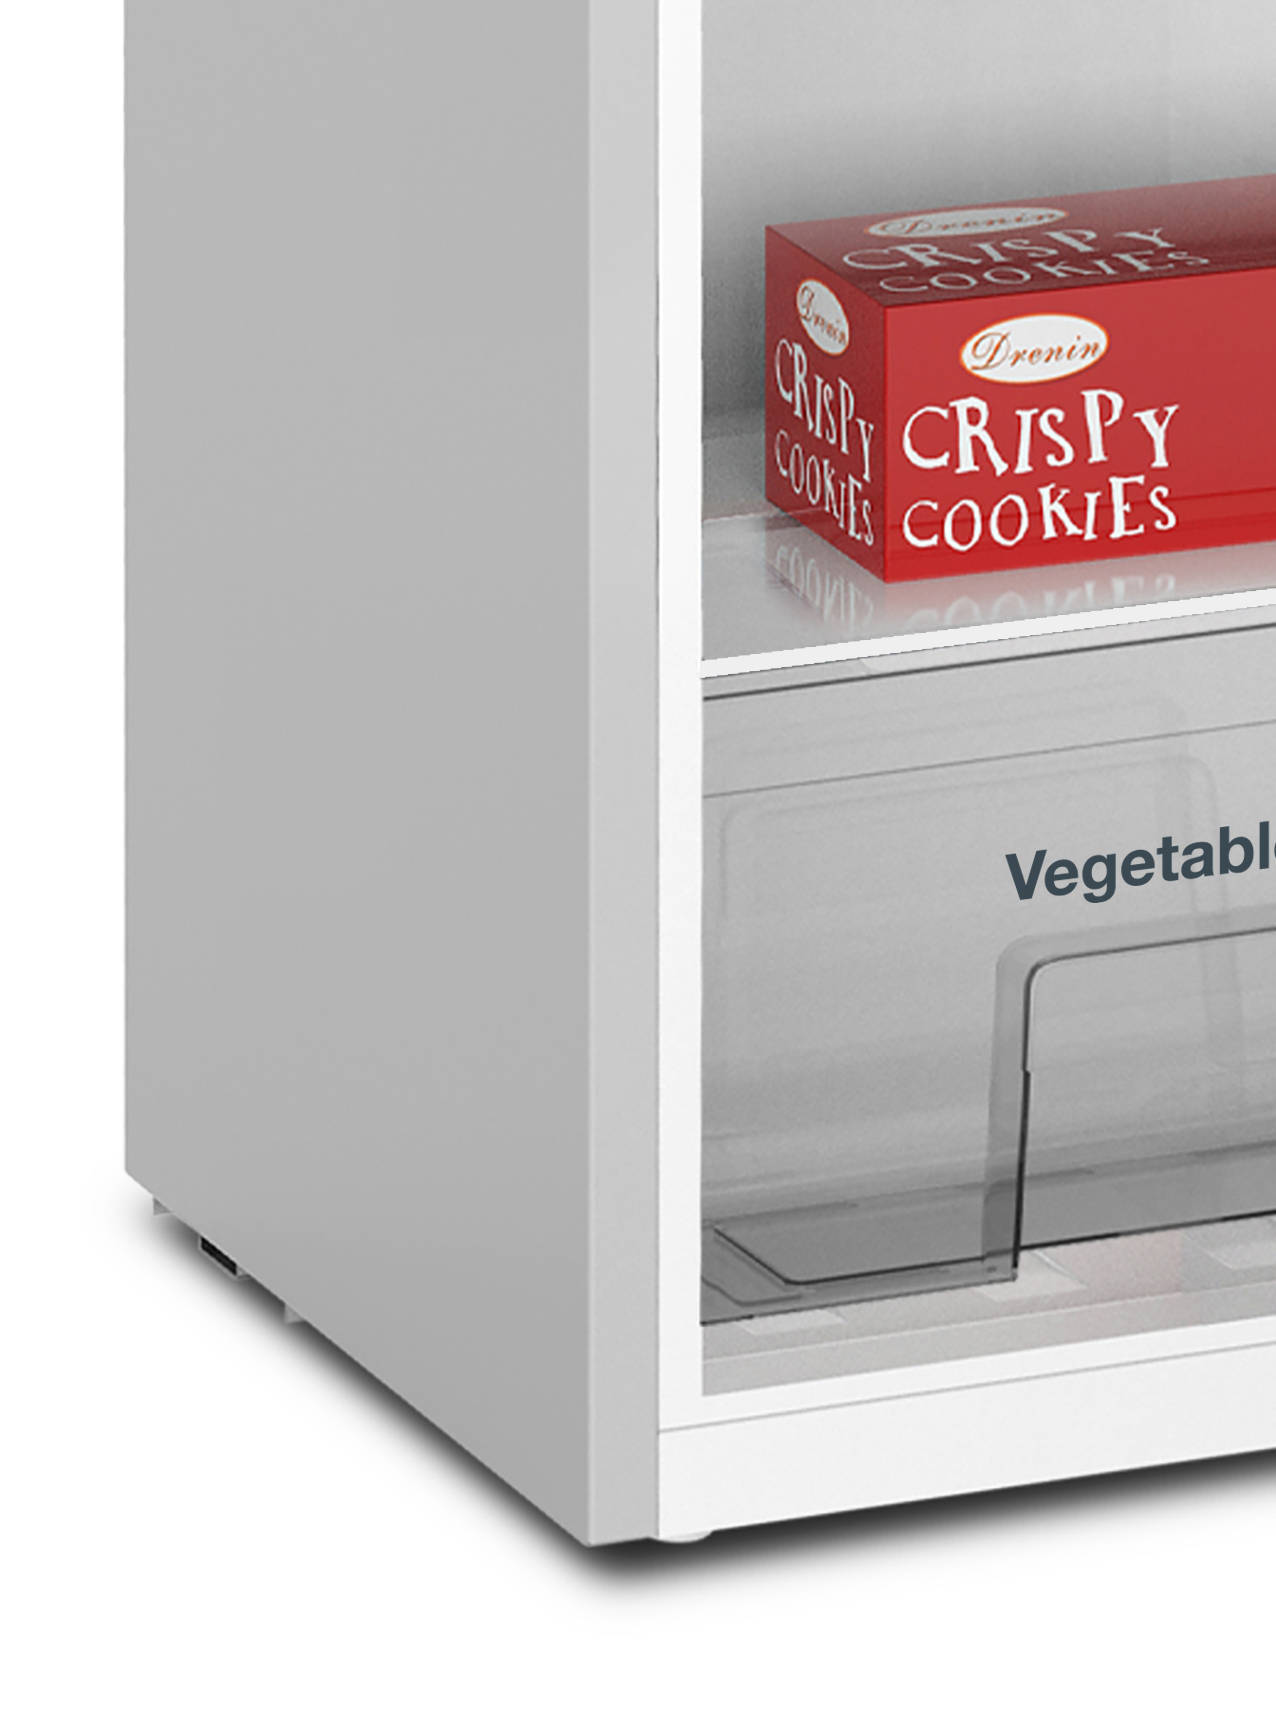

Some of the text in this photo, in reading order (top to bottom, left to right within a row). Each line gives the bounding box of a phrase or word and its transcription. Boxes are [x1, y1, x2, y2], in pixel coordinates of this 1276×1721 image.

[842, 227, 1176, 270] CRISPY
[878, 250, 1210, 292] COOKIES
[970, 331, 1101, 371] Drenin
[775, 338, 874, 483] CRISPY
[902, 388, 1180, 477] CRISPY
[775, 429, 874, 546] COOKIES
[903, 474, 1178, 552] COOKIES
